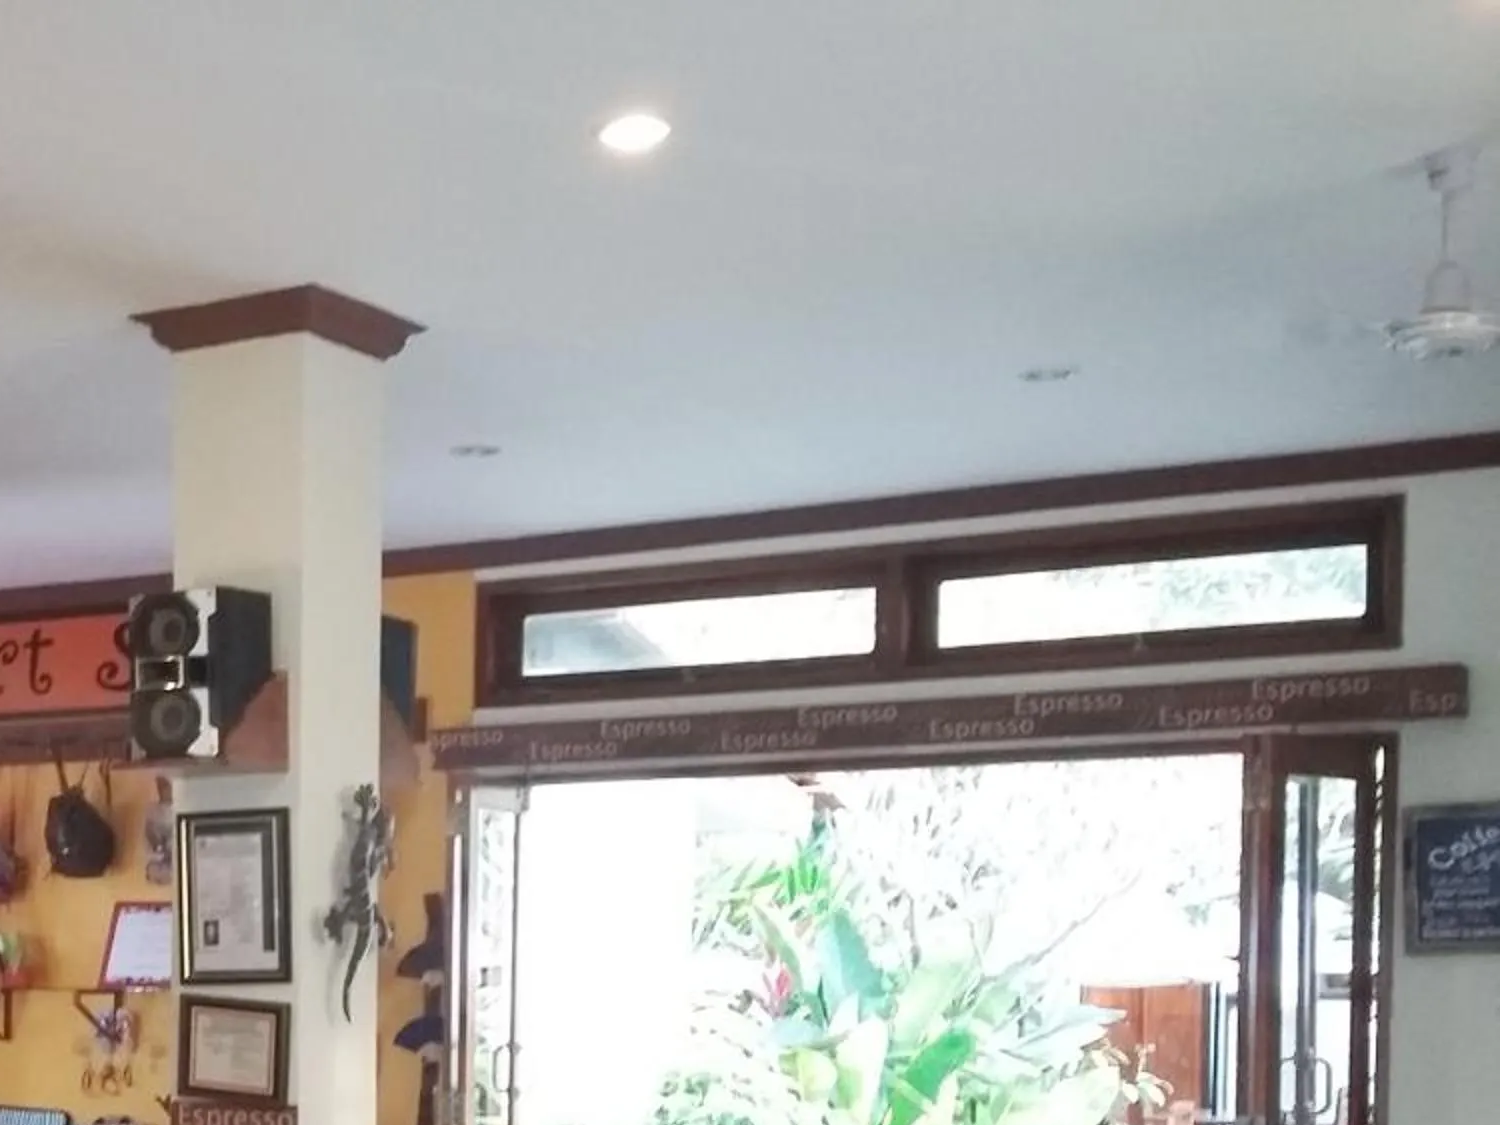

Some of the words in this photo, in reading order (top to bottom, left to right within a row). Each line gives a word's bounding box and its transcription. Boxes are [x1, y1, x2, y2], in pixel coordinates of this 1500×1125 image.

[529, 739, 618, 763] Espresso
[720, 729, 817, 752] Espresso
[928, 716, 1035, 742] Espresso
[1158, 702, 1274, 728] Espresso
[1409, 688, 1458, 714] Esp
[601, 717, 692, 744] Espresso
[797, 704, 898, 730] Espresso
[1013, 692, 1124, 718] Espresso
[1252, 675, 1370, 702] Espresso
